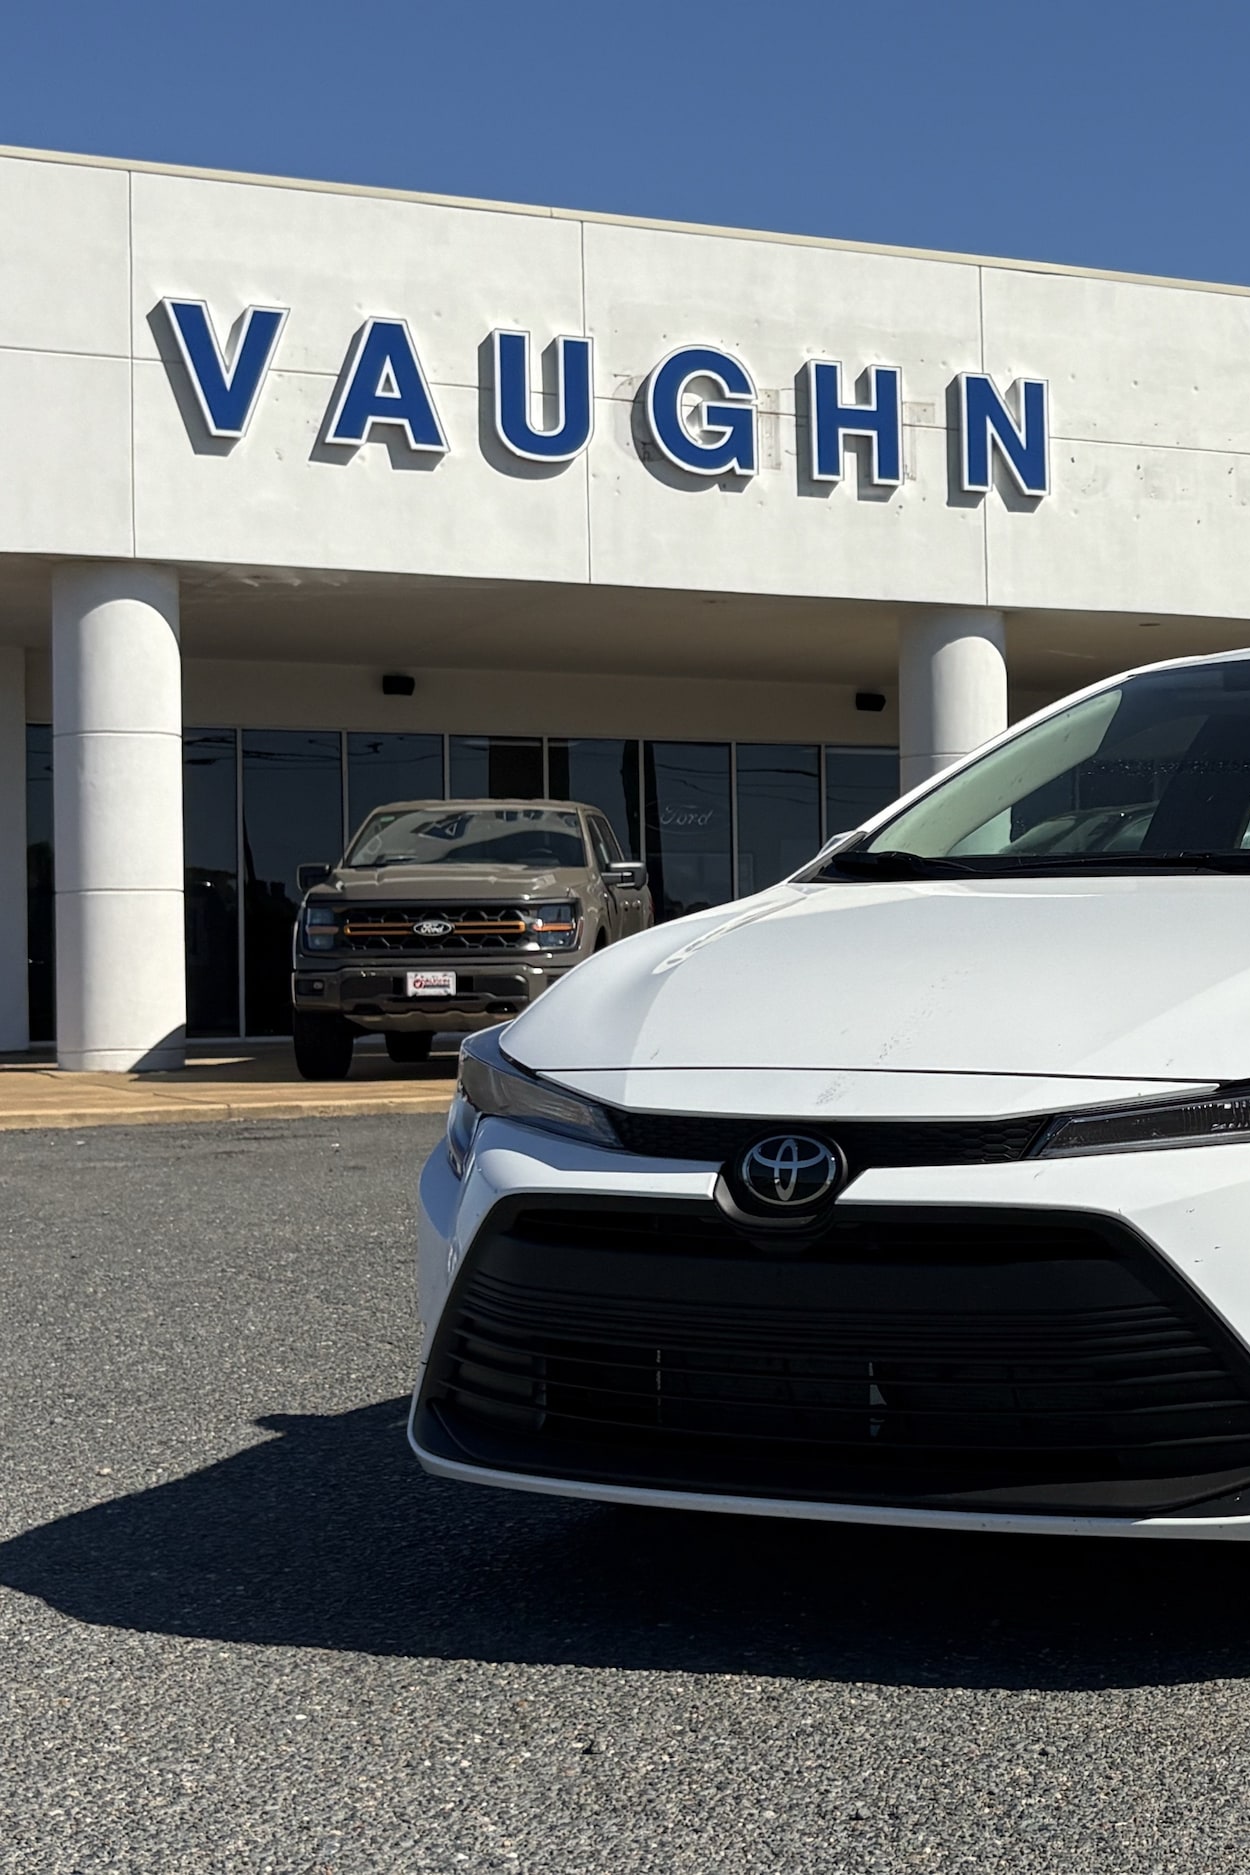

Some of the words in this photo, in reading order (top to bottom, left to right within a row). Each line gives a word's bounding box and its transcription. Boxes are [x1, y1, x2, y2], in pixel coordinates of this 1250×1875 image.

[162, 296, 1049, 497] VAUGHN
[660, 804, 713, 826] Ford
[419, 921, 447, 934] Ford
